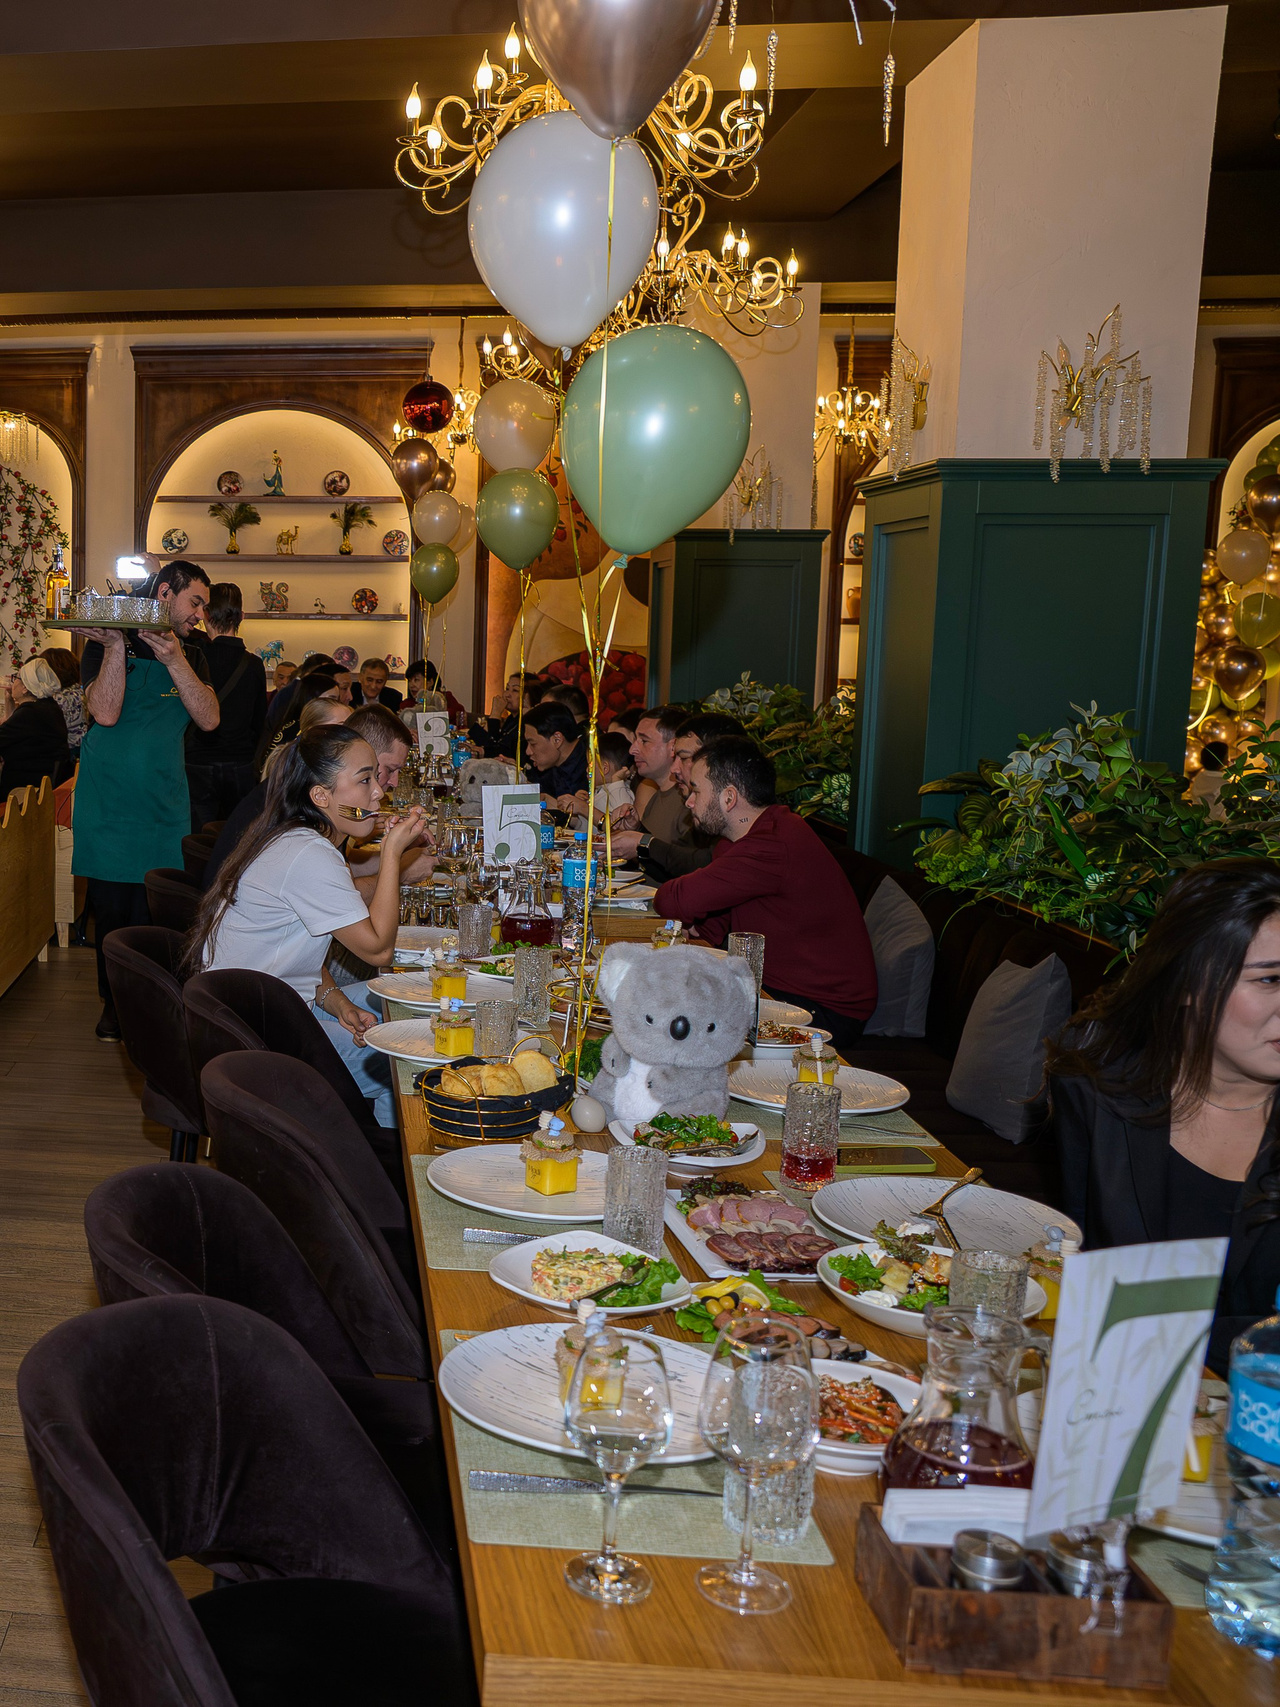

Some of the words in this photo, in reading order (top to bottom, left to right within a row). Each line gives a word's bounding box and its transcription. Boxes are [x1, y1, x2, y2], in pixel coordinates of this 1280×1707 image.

[424, 716, 451, 757] 3
[494, 793, 542, 863] 5
[1091, 1274, 1222, 1521] 7
